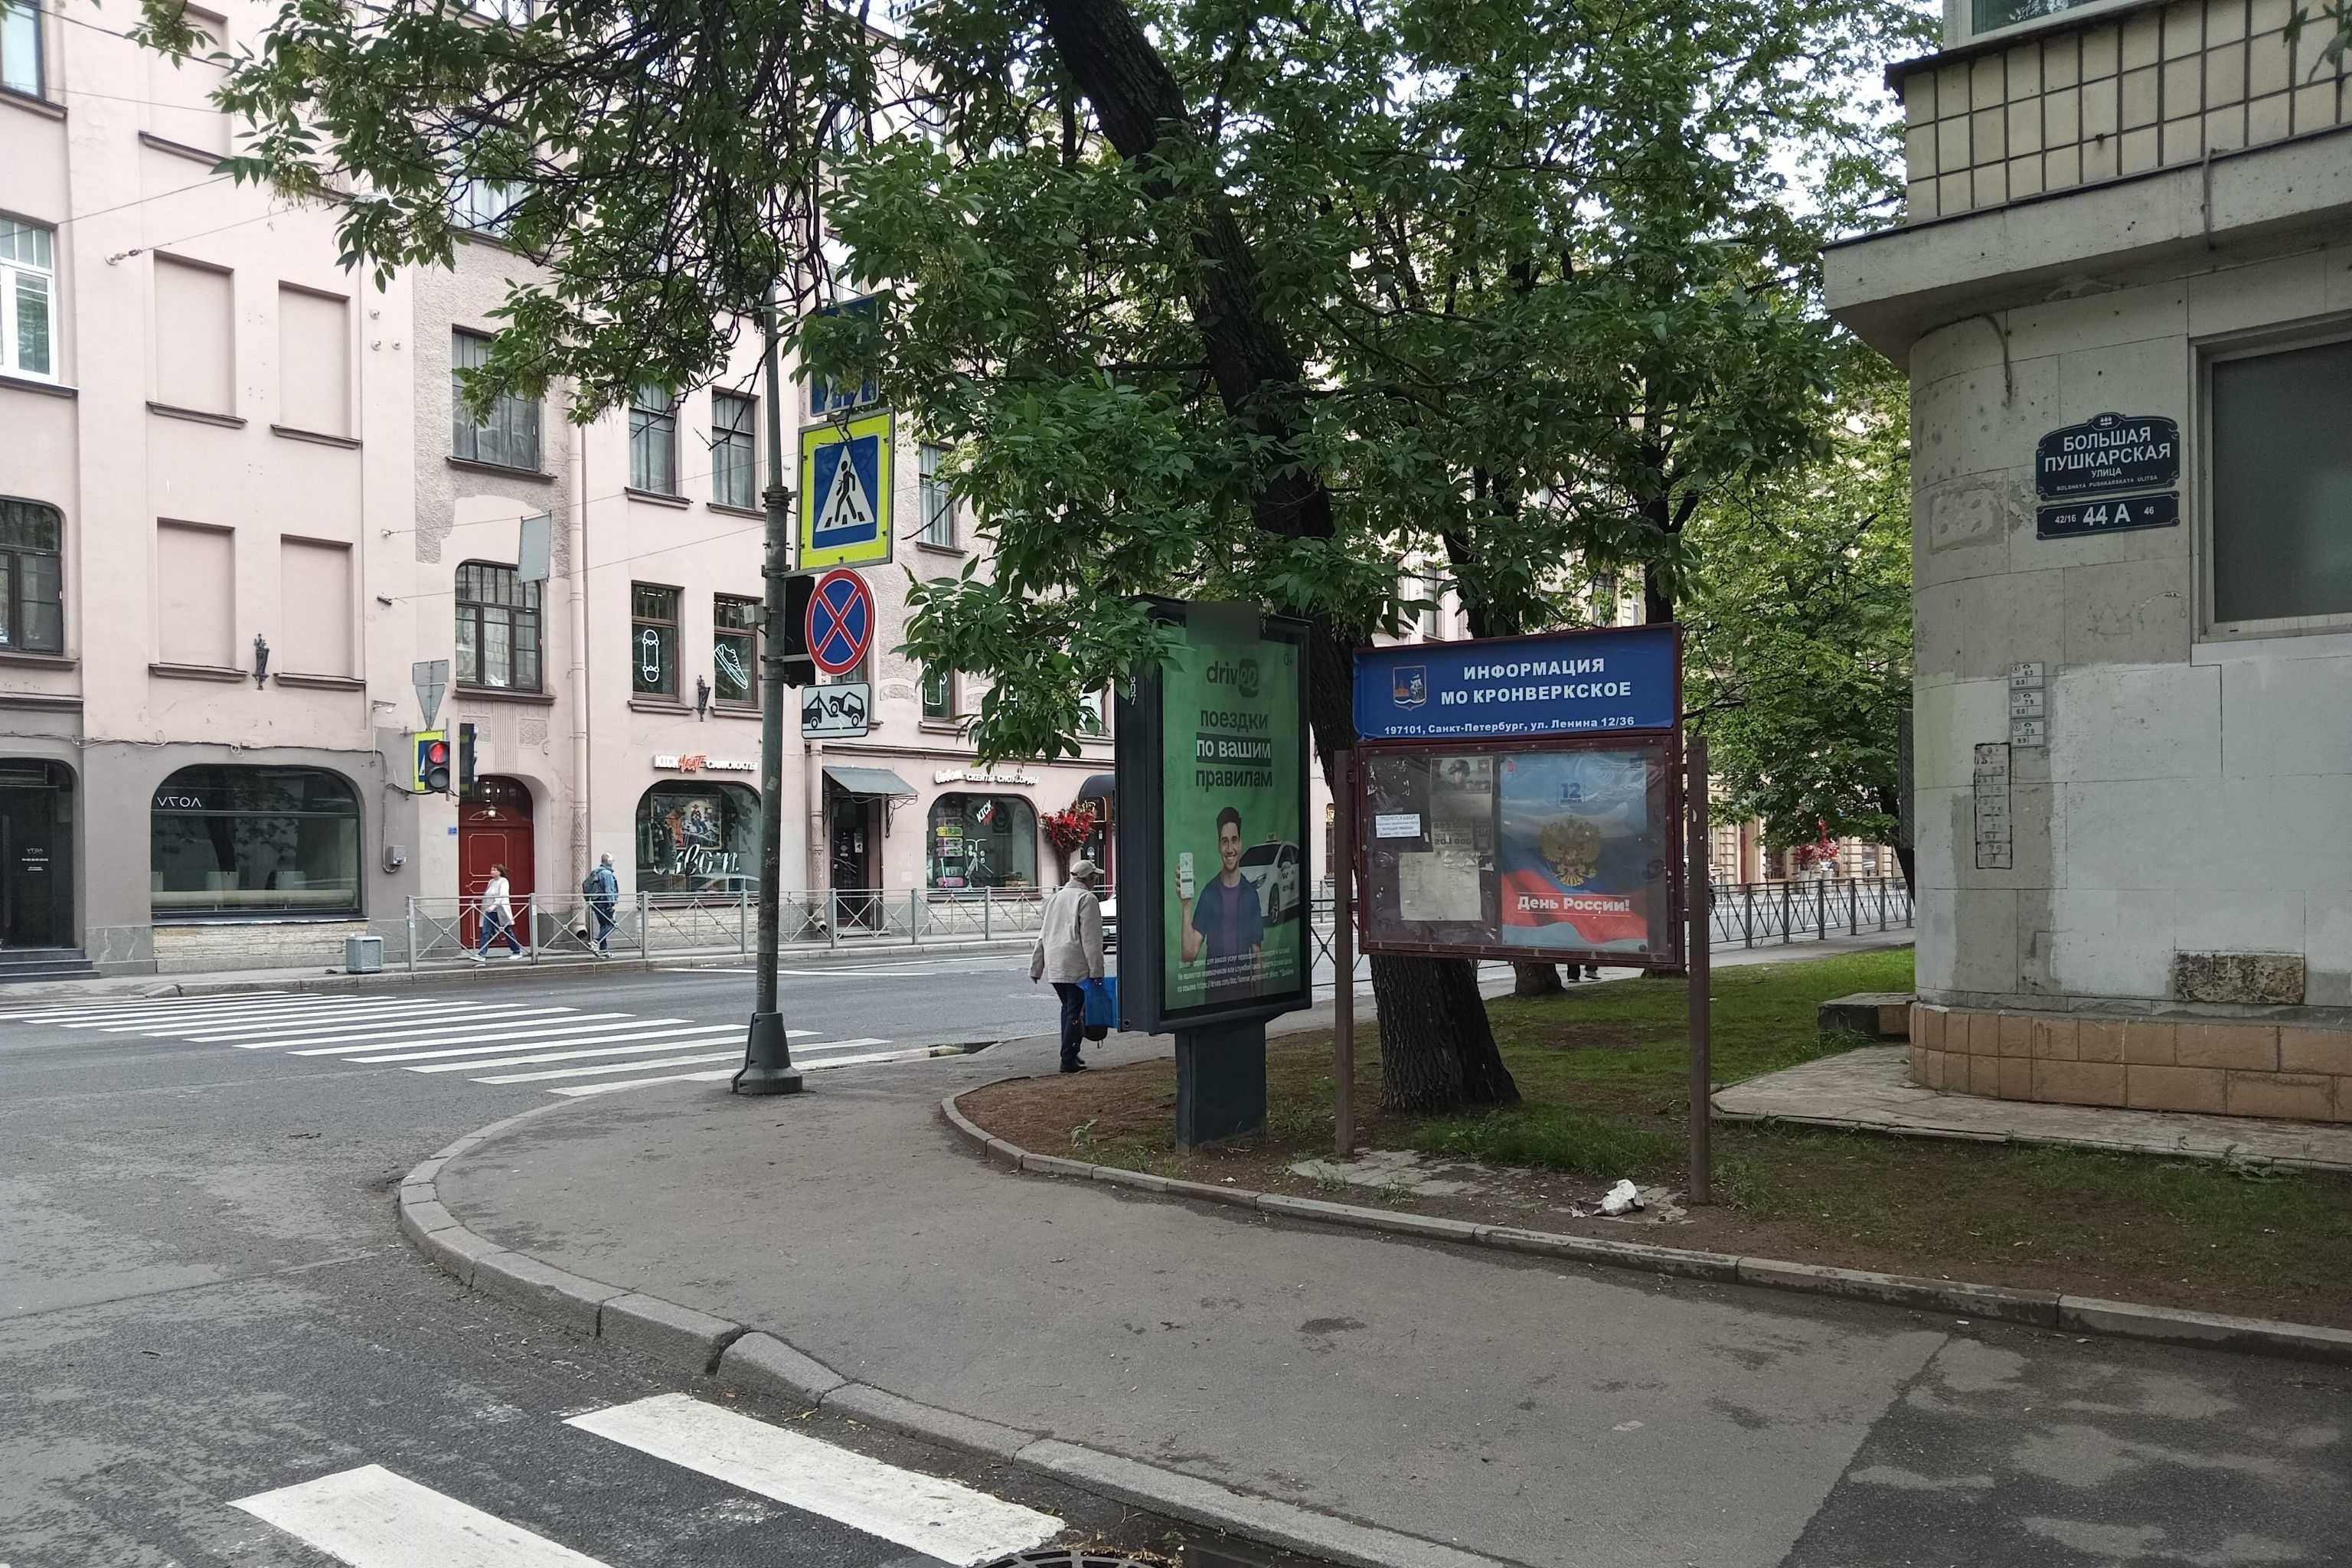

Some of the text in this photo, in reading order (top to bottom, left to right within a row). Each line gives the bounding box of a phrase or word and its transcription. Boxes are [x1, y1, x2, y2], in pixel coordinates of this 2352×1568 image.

[2063, 426, 2151, 452] БОЛЬШАЯ
[2045, 443, 2171, 472] ПУШКАРСКАЯ
[2089, 478, 2135, 488] PUSHKARSKAYA
[2137, 475, 2158, 483] ULITSA
[2091, 467, 2122, 479] УЛИЦА
[2054, 503, 2154, 527] 42/16 44 А 46
[1463, 658, 1605, 681] ИНФОРМАЦИЯ
[1441, 681, 1632, 705] МО КРОНВЕРКСКОЕ
[1200, 710, 1269, 733] поездки
[1384, 717, 1635, 735] 197101, Санкт-Петербург, ул. Ленина 12/36
[1197, 740, 1272, 759] по вашим
[1196, 769, 1272, 792] правилам
[1560, 782, 1581, 798] 12
[1517, 896, 1630, 911] День России!
